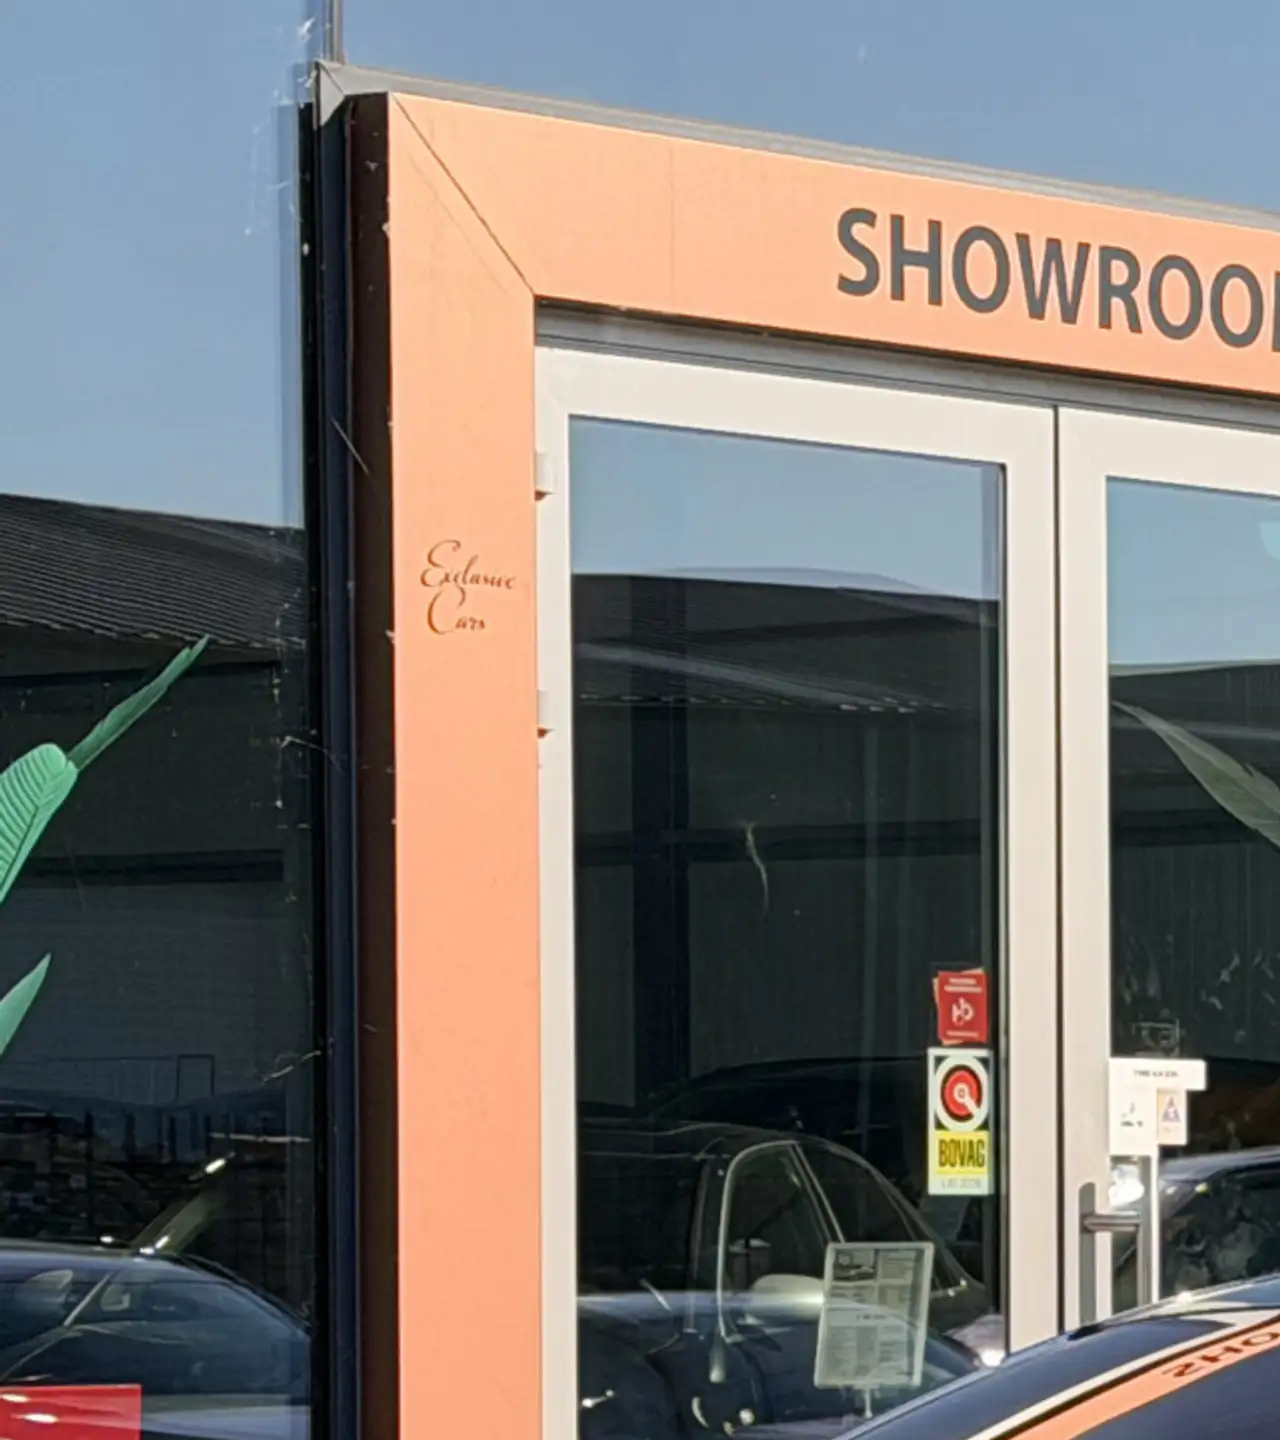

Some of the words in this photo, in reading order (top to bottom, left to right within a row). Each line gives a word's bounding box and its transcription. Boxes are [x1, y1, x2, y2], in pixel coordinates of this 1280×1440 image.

[420, 539, 516, 590] Exclusive
[427, 589, 486, 635] Cars
[938, 1138, 986, 1168] BOVAG
